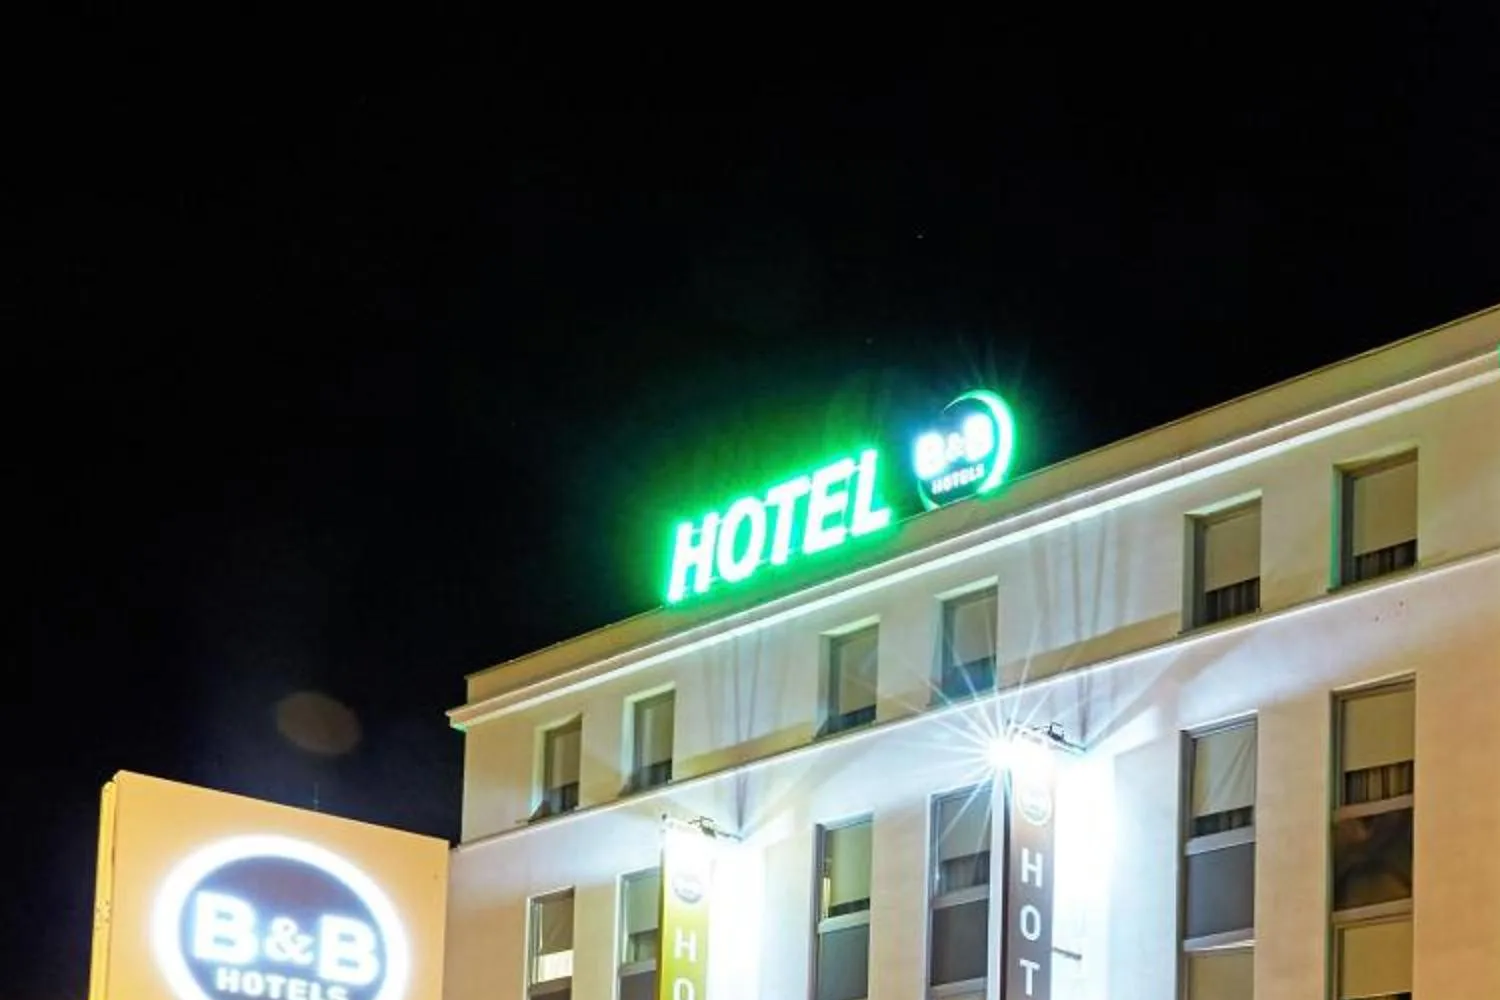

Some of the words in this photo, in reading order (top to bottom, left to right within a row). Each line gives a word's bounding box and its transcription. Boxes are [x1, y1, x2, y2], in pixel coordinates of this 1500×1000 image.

[914, 414, 995, 477] B&B
[931, 463, 987, 495] HOTELS
[666, 449, 890, 603] HOTEL
[195, 893, 380, 986] B&B
